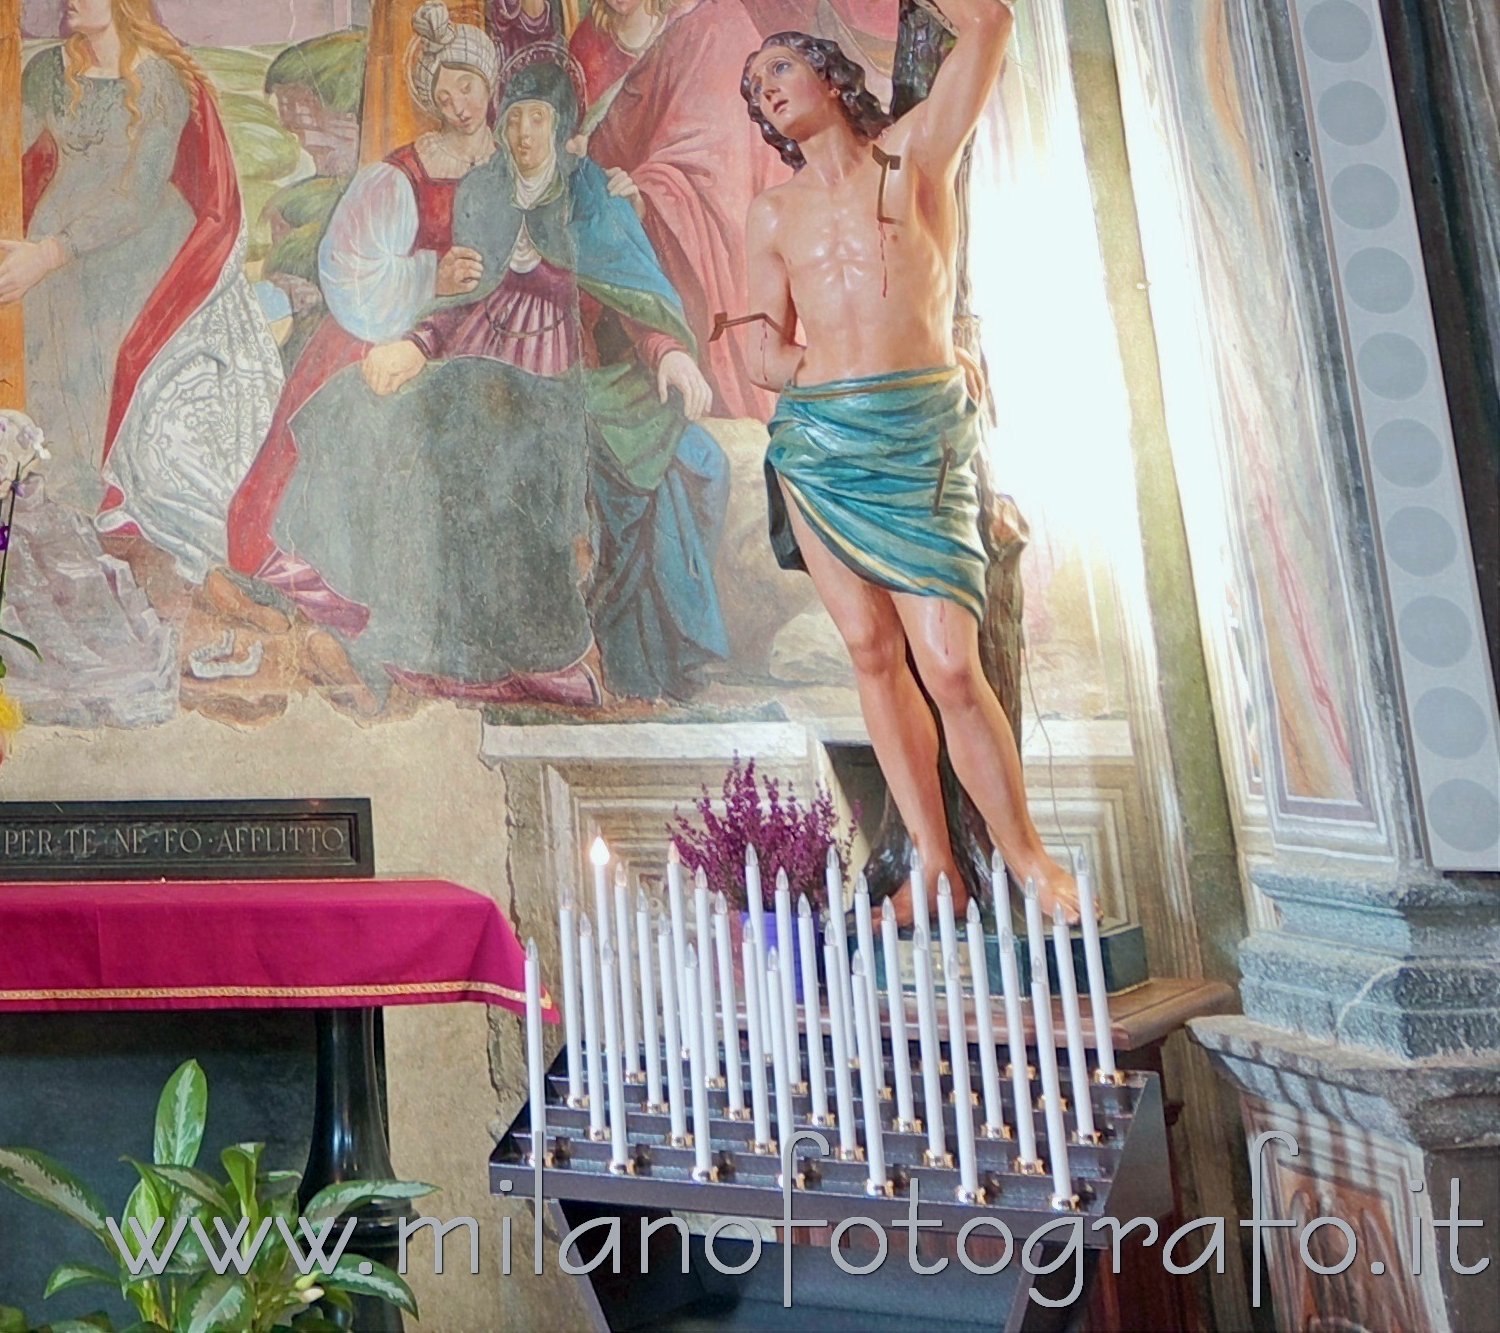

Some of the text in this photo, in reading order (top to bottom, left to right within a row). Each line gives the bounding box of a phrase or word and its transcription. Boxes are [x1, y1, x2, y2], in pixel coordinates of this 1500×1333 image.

[4, 826, 53, 854] PER
[63, 826, 97, 854] TE
[113, 825, 148, 854] NE
[163, 824, 205, 853] FO
[216, 823, 345, 853] AFFLITTO
